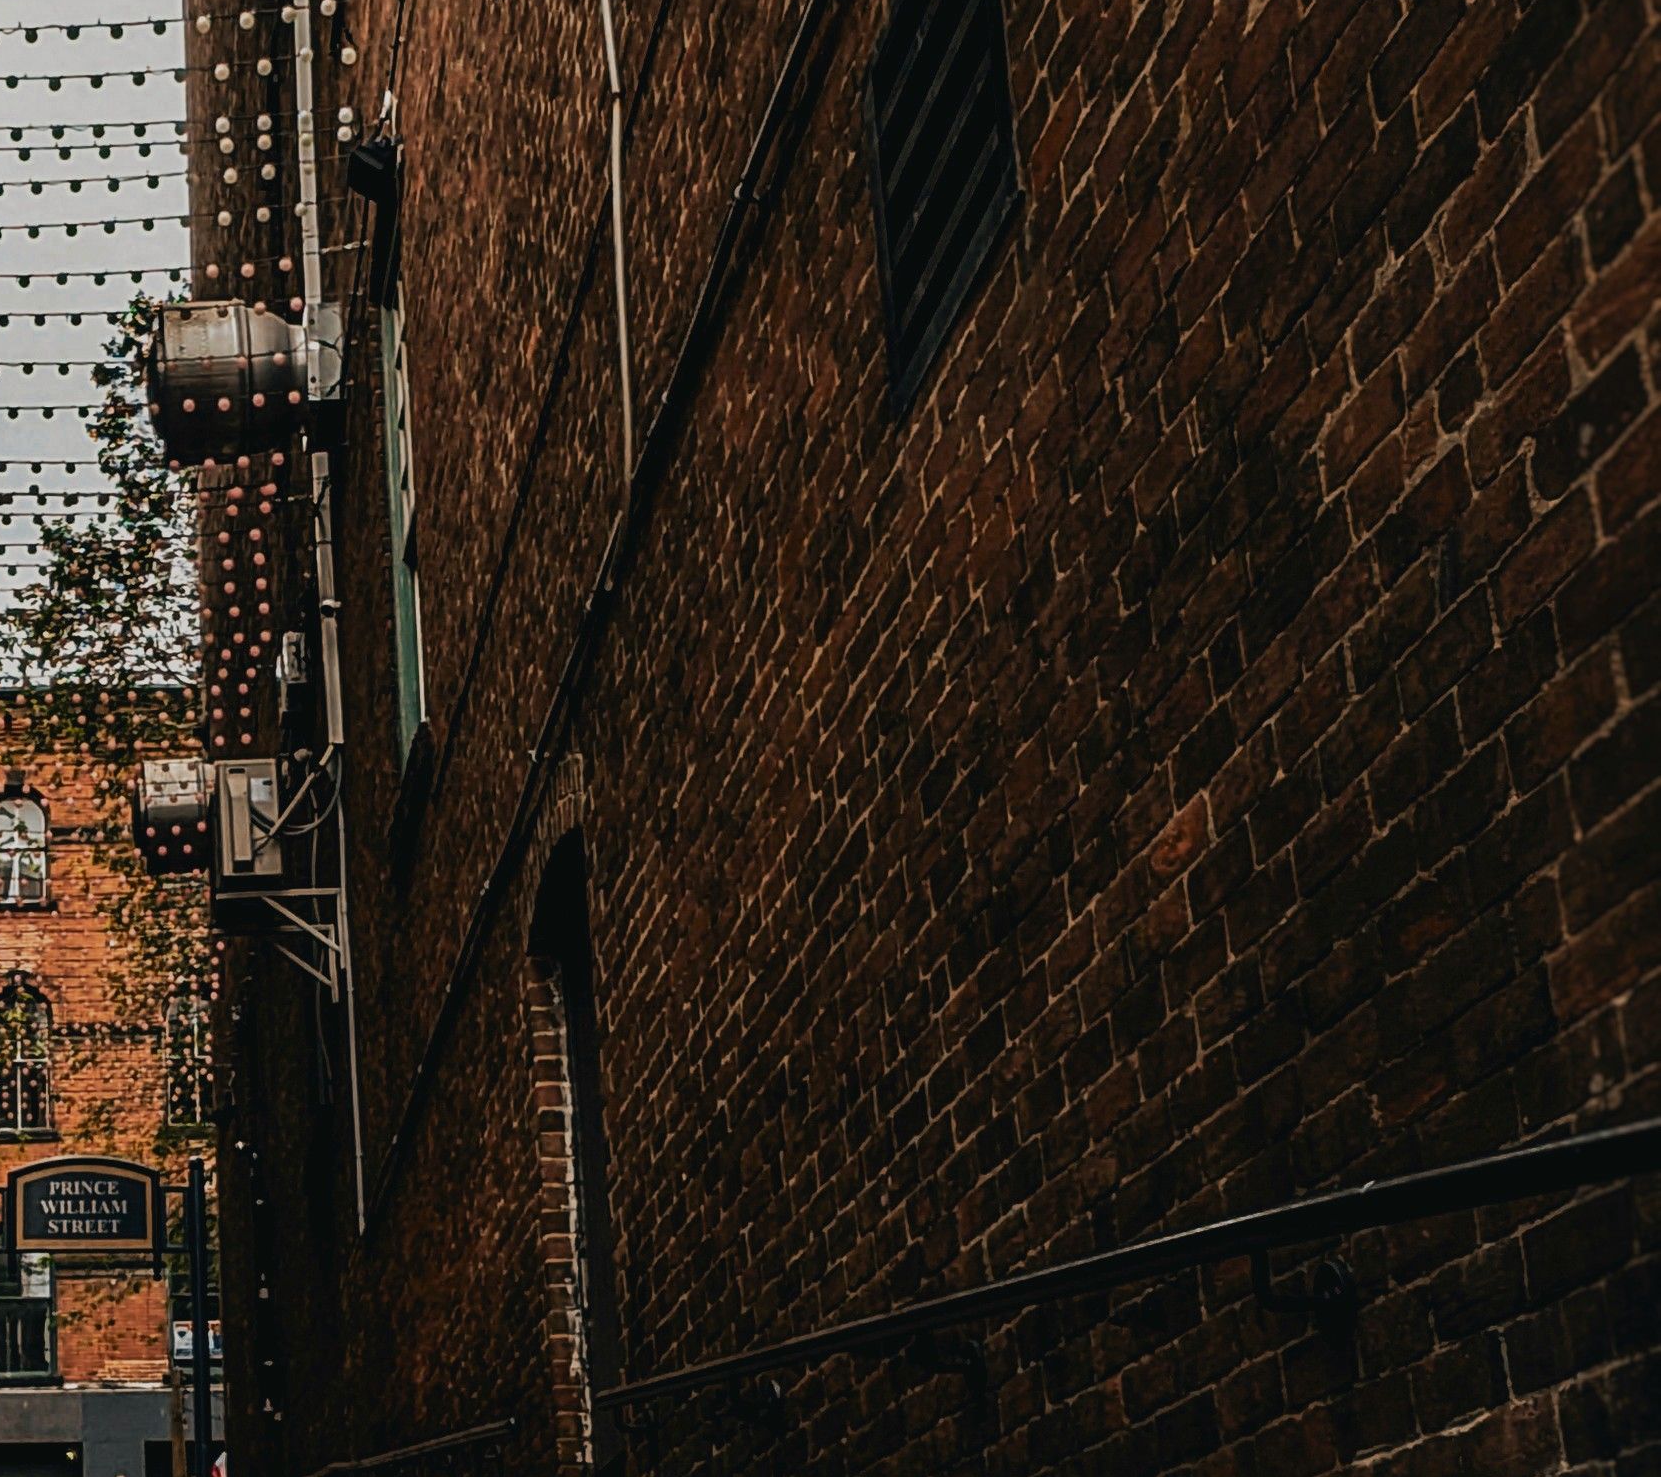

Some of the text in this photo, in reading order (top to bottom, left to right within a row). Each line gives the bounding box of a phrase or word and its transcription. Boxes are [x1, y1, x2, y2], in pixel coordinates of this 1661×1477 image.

[49, 1180, 119, 1195] PRINCE
[40, 1199, 128, 1214] WILLIAM
[47, 1219, 120, 1234] STREET
